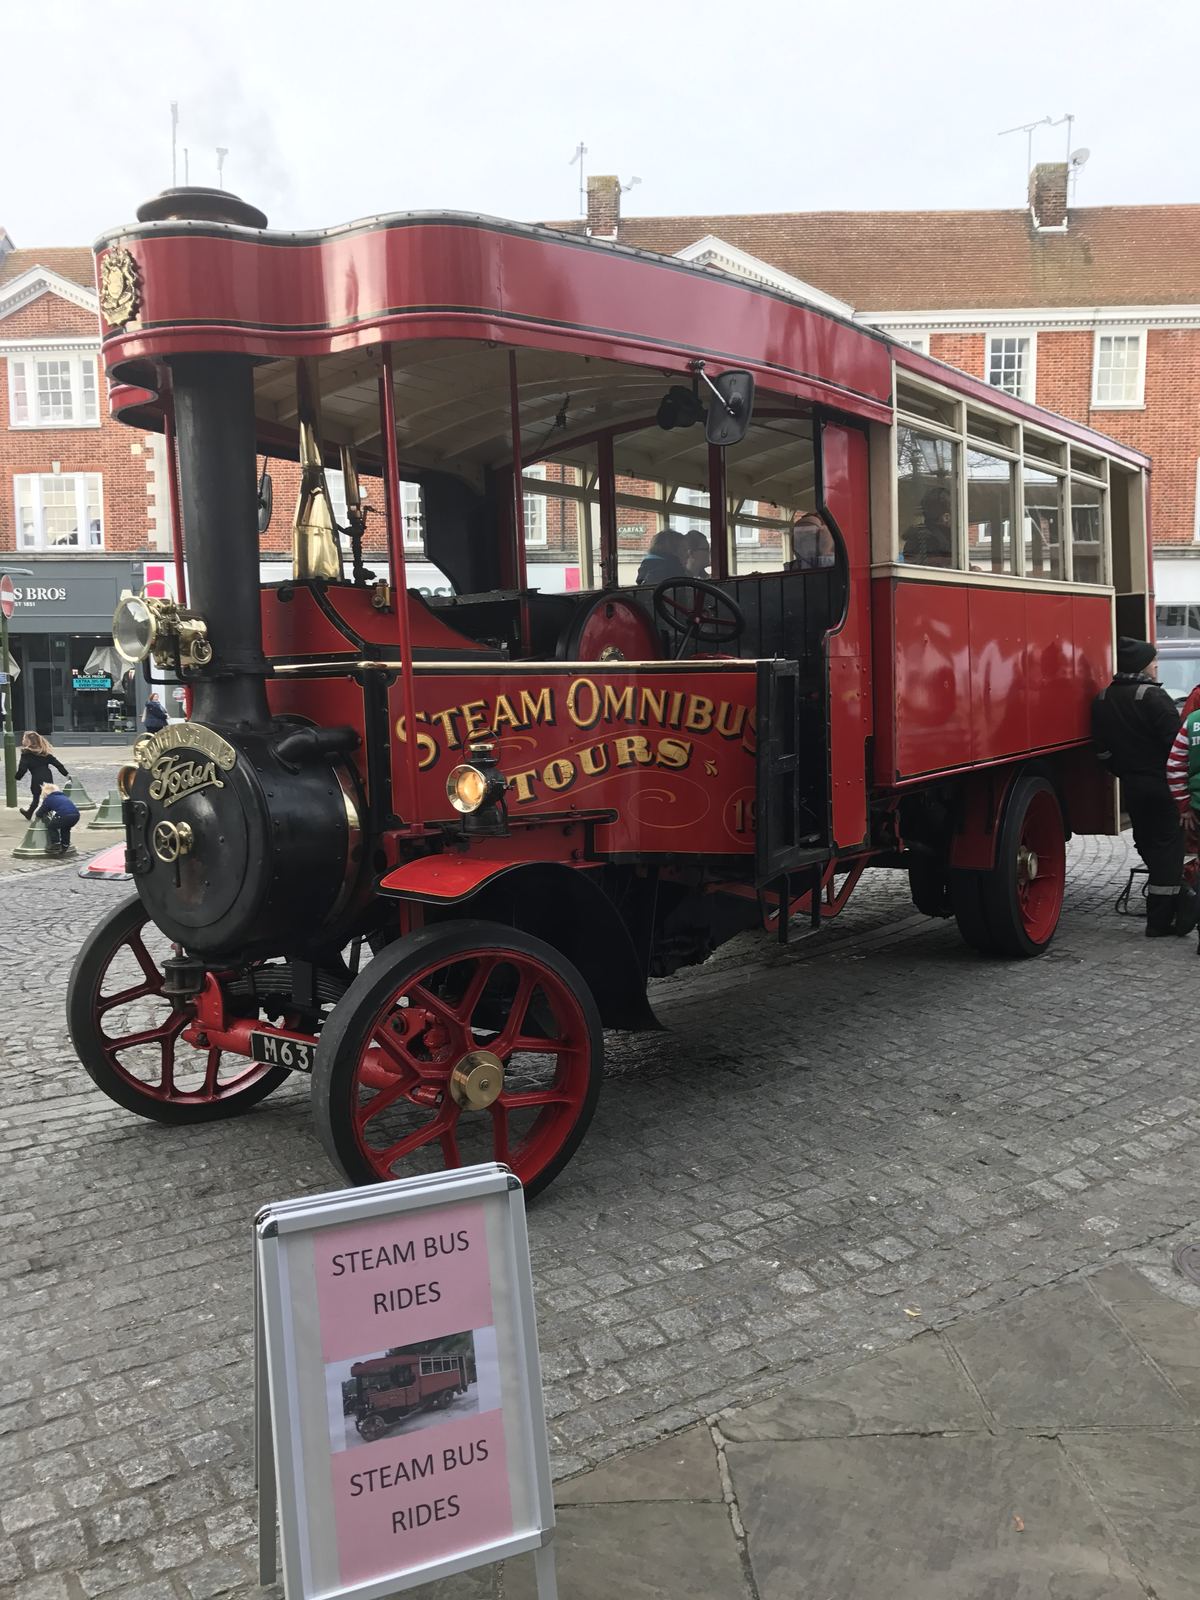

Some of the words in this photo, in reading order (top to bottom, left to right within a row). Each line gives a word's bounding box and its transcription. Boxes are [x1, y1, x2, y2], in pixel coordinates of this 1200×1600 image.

[396, 687, 553, 769] STEAM
[149, 755, 224, 807] Foden
[510, 735, 692, 802] TOURS
[263, 1036, 317, 1070] M63
[331, 1240, 416, 1277] STEAM
[424, 1230, 470, 1260] BUS
[373, 1281, 441, 1315] RIDES
[349, 1454, 435, 1498] STEAM
[443, 1439, 490, 1475] BUS
[391, 1494, 461, 1535] RIDES
